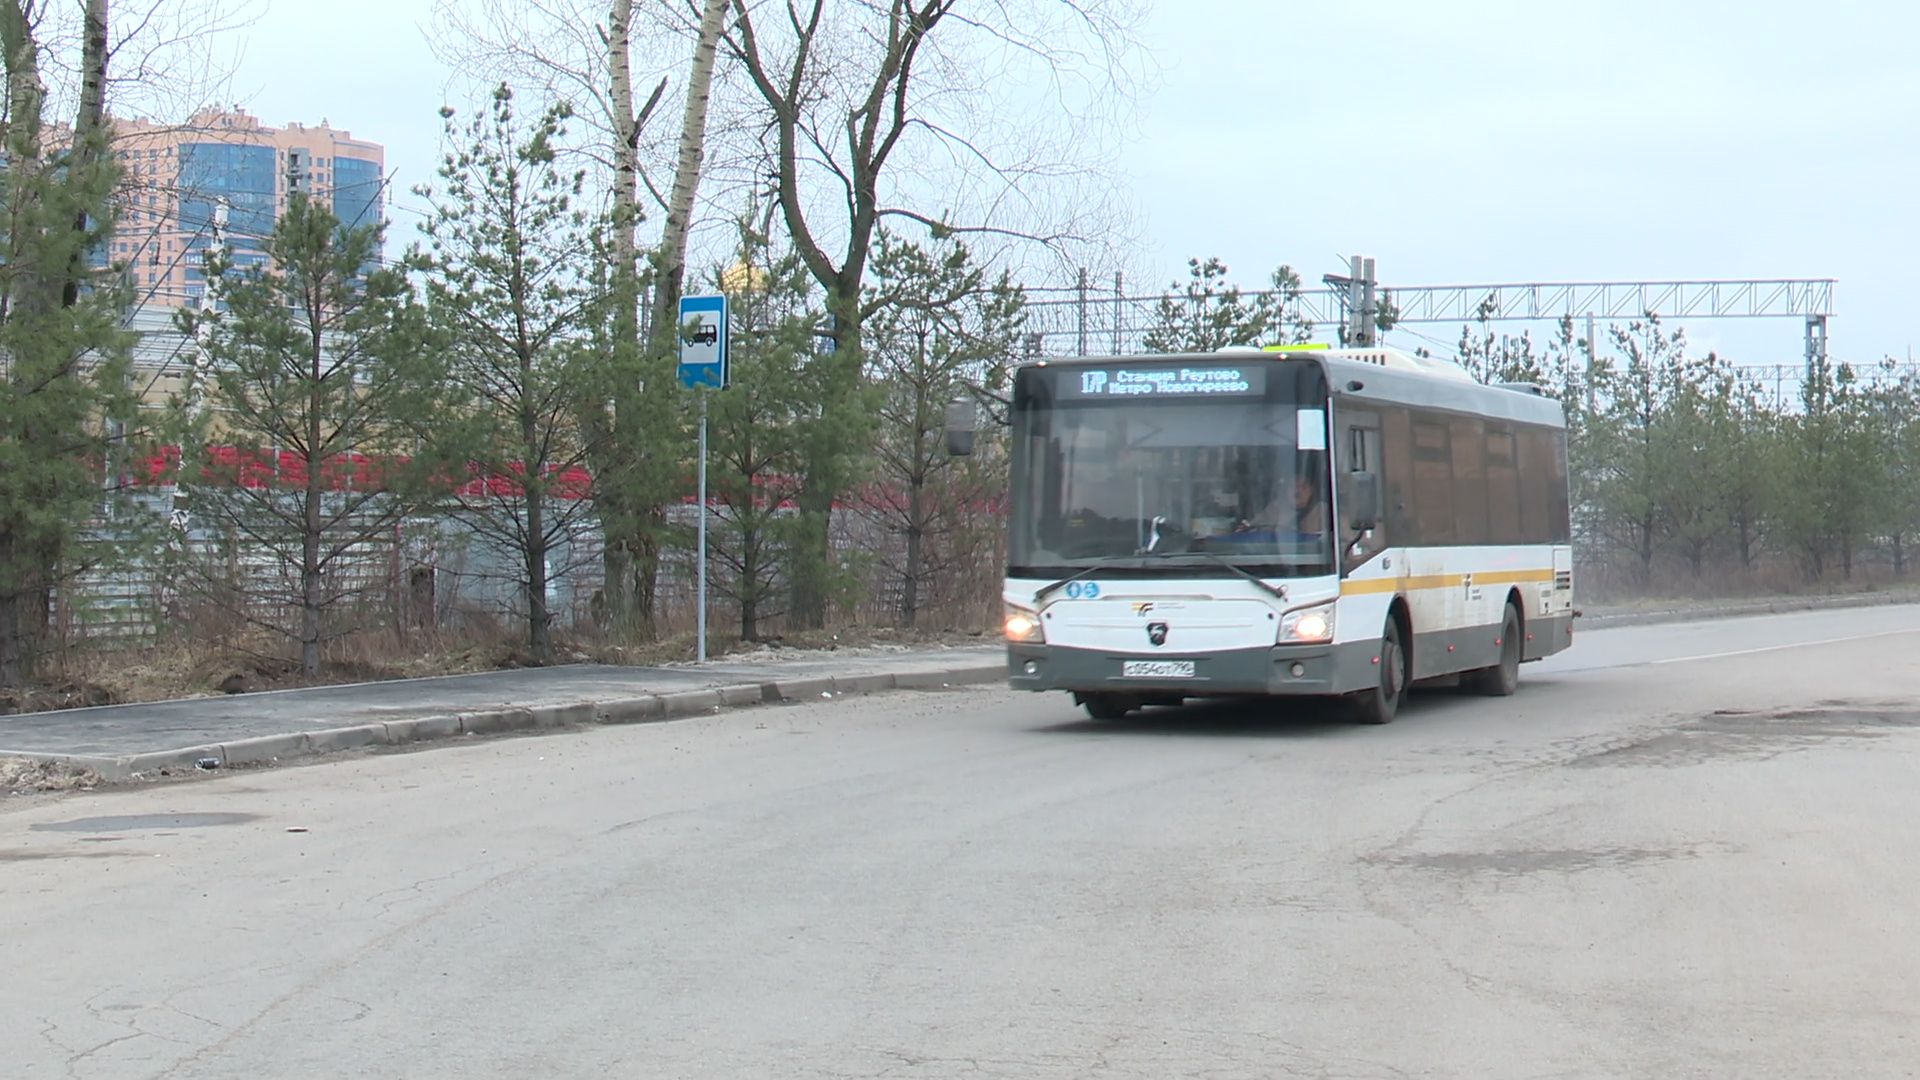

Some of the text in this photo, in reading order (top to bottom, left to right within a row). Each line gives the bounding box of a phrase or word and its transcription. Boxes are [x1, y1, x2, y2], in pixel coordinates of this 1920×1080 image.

[1117, 368, 1240, 383] Станция Реутово
[1108, 382, 1153, 395] Метро
